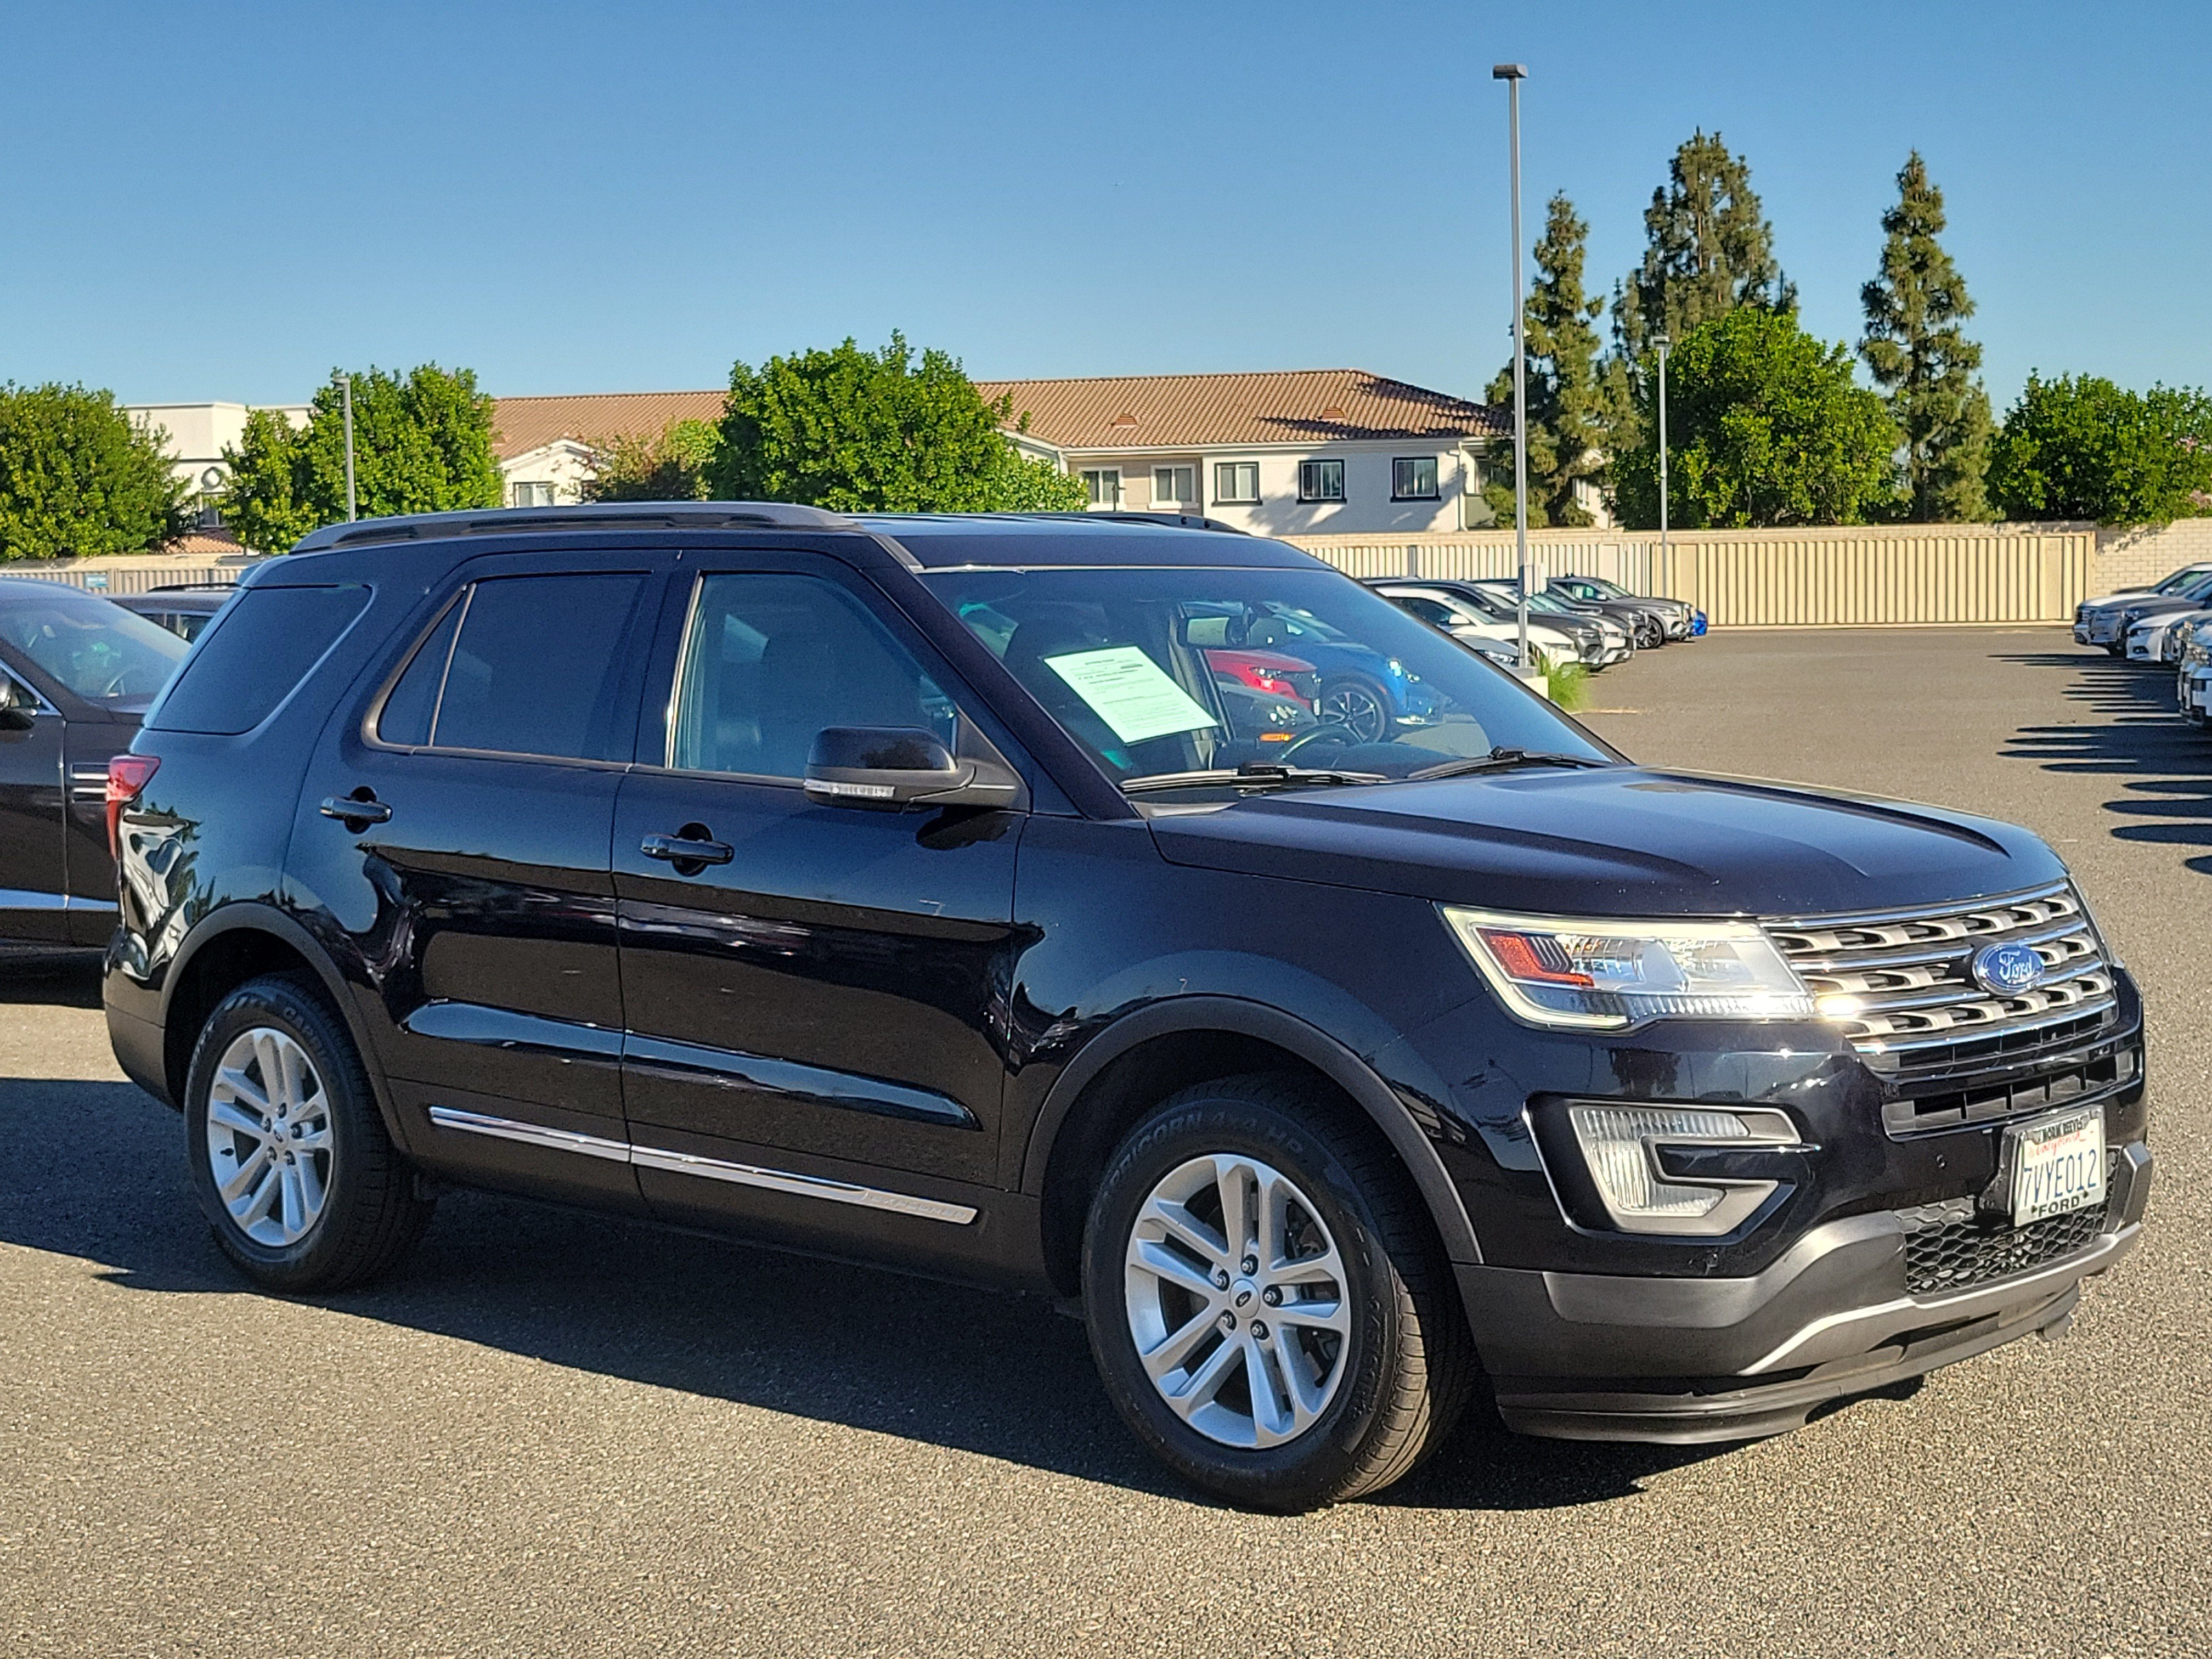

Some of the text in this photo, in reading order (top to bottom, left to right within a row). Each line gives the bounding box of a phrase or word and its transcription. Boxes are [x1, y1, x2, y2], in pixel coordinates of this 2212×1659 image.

[1999, 950, 2035, 980] Ford
[2023, 1149, 2097, 1207] 7VYE012
[2038, 1195, 2080, 1217] FORD
